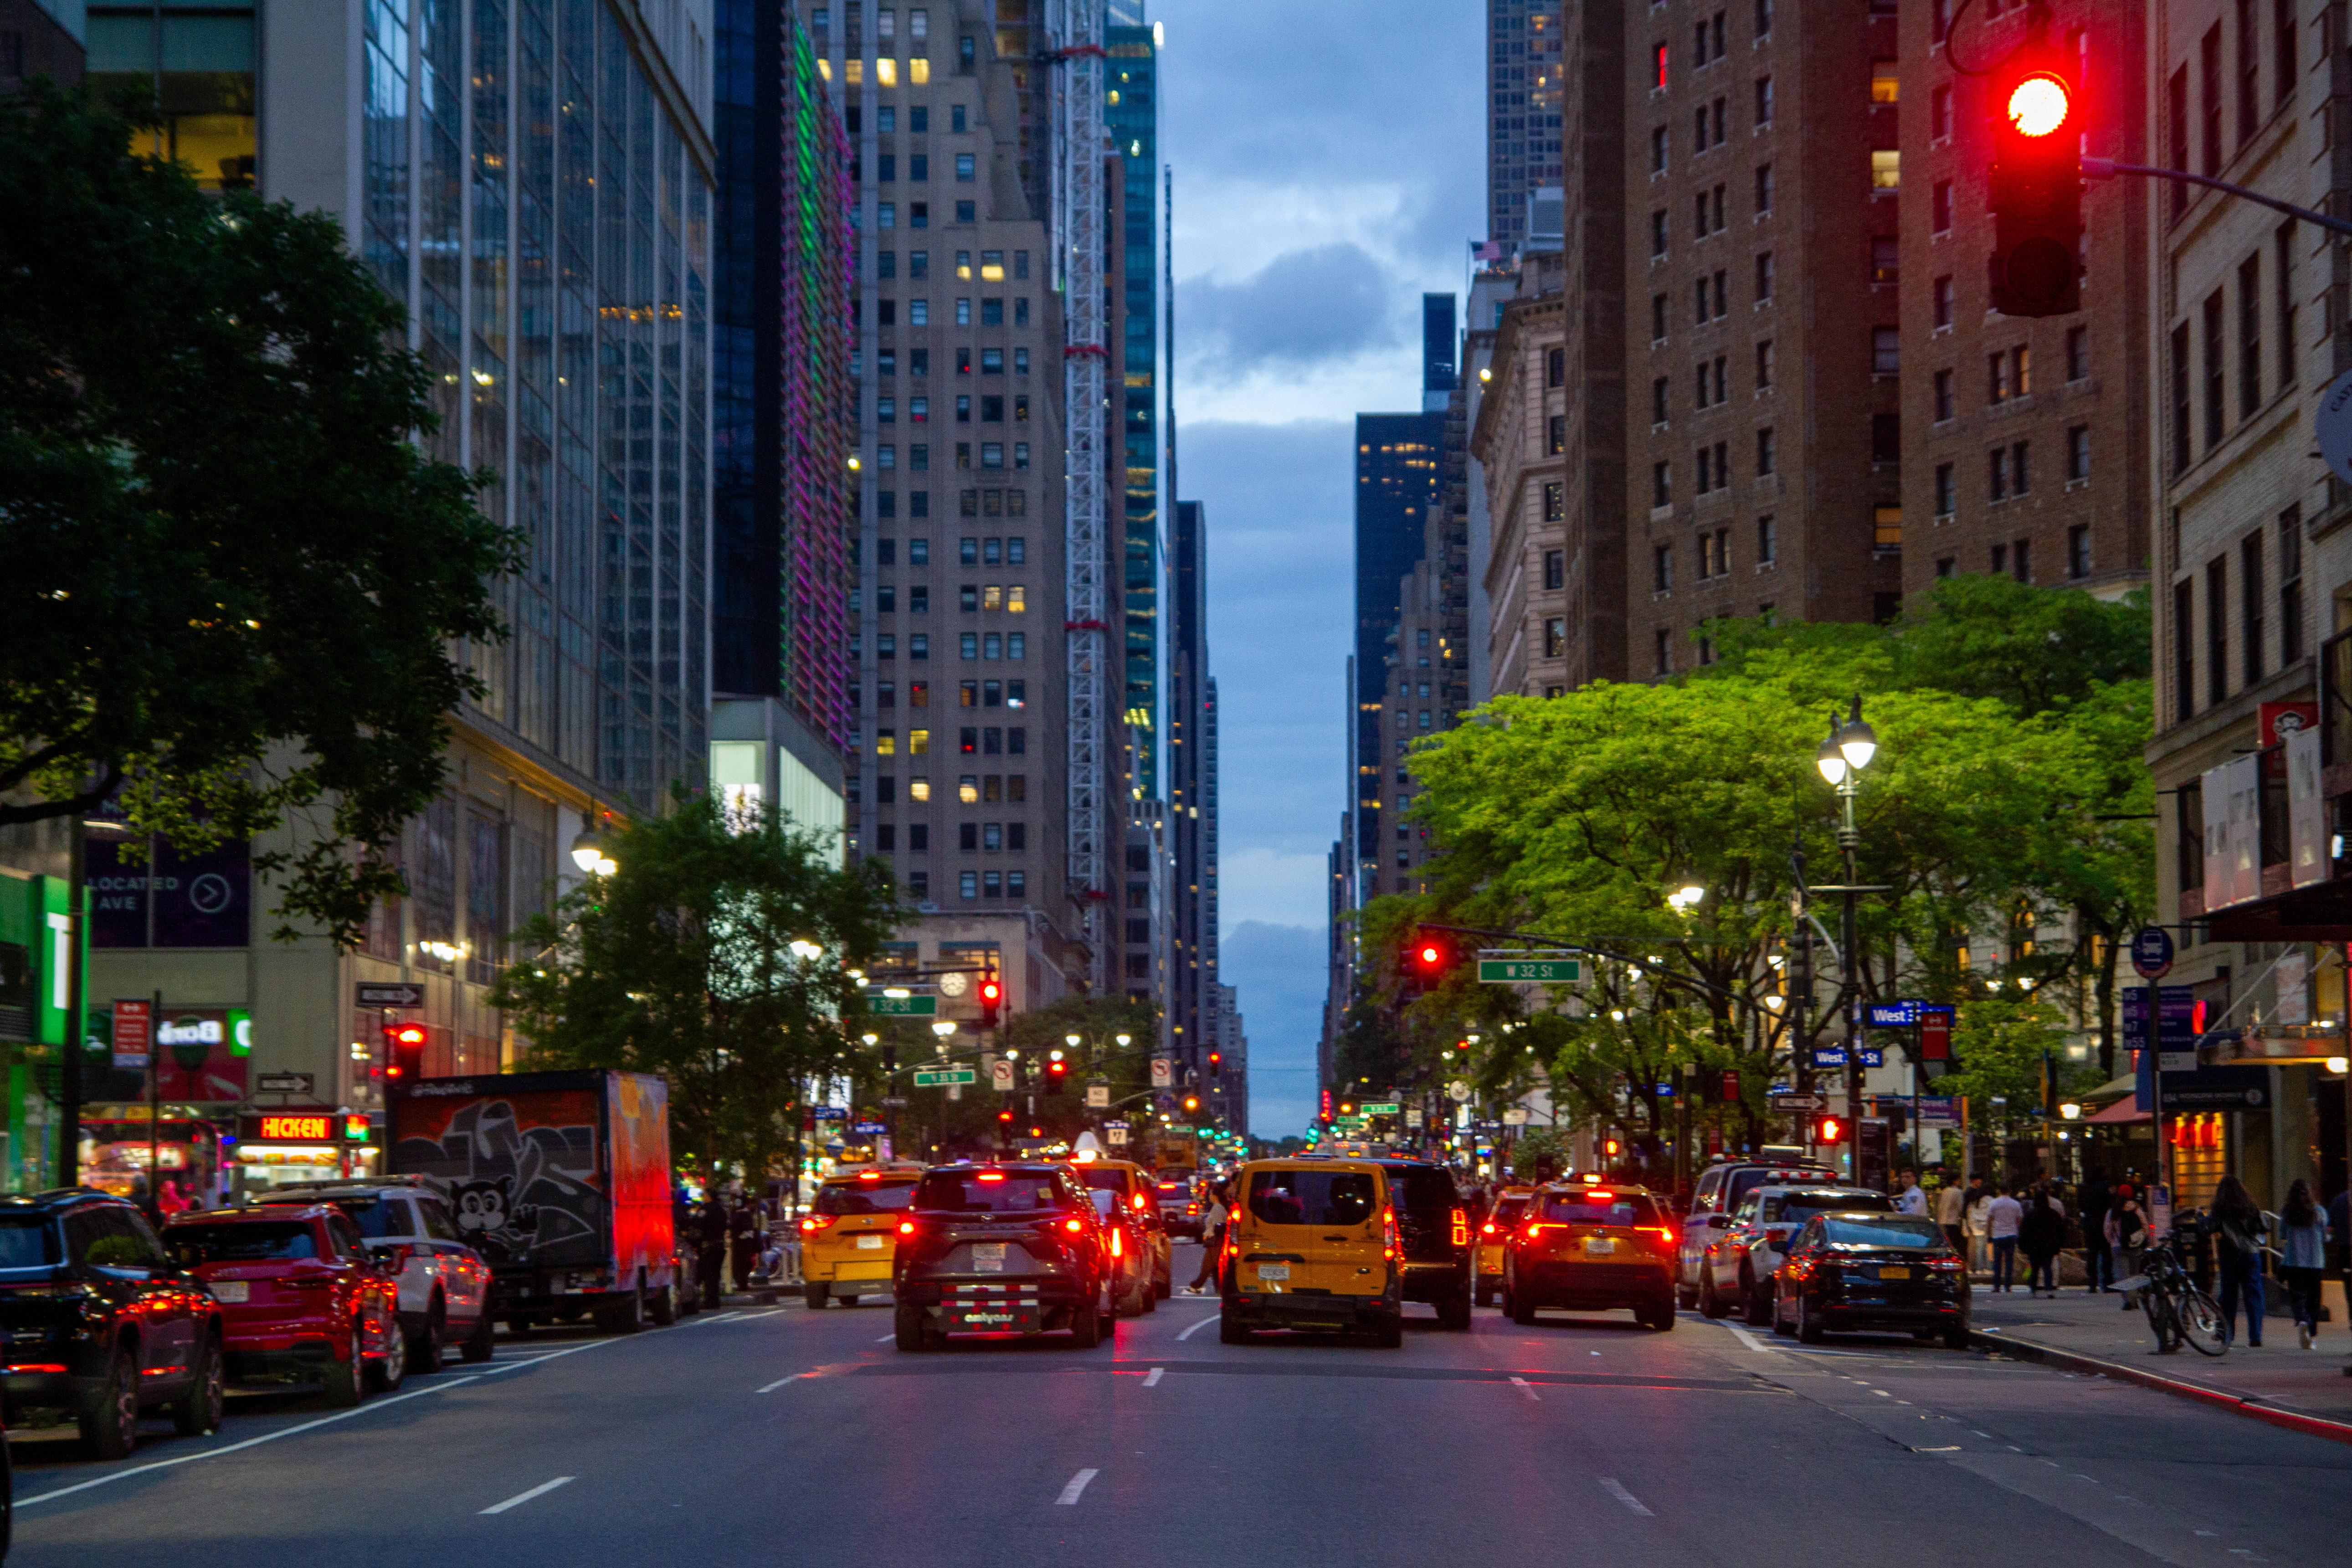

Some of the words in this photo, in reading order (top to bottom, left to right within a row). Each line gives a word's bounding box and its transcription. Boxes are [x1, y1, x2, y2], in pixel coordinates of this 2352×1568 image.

[87, 876, 179, 891] LOCATED
[98, 895, 137, 911] AVE
[1506, 965, 1515, 977] W
[1520, 964, 1536, 977] 32
[1541, 964, 1553, 977] St
[880, 1000, 894, 1012] 32
[899, 1000, 911, 1012] St
[1872, 1008, 1905, 1022] West
[1816, 1052, 1843, 1063] West
[1866, 1052, 1879, 1064] St
[262, 1117, 326, 1138] HICKEN
